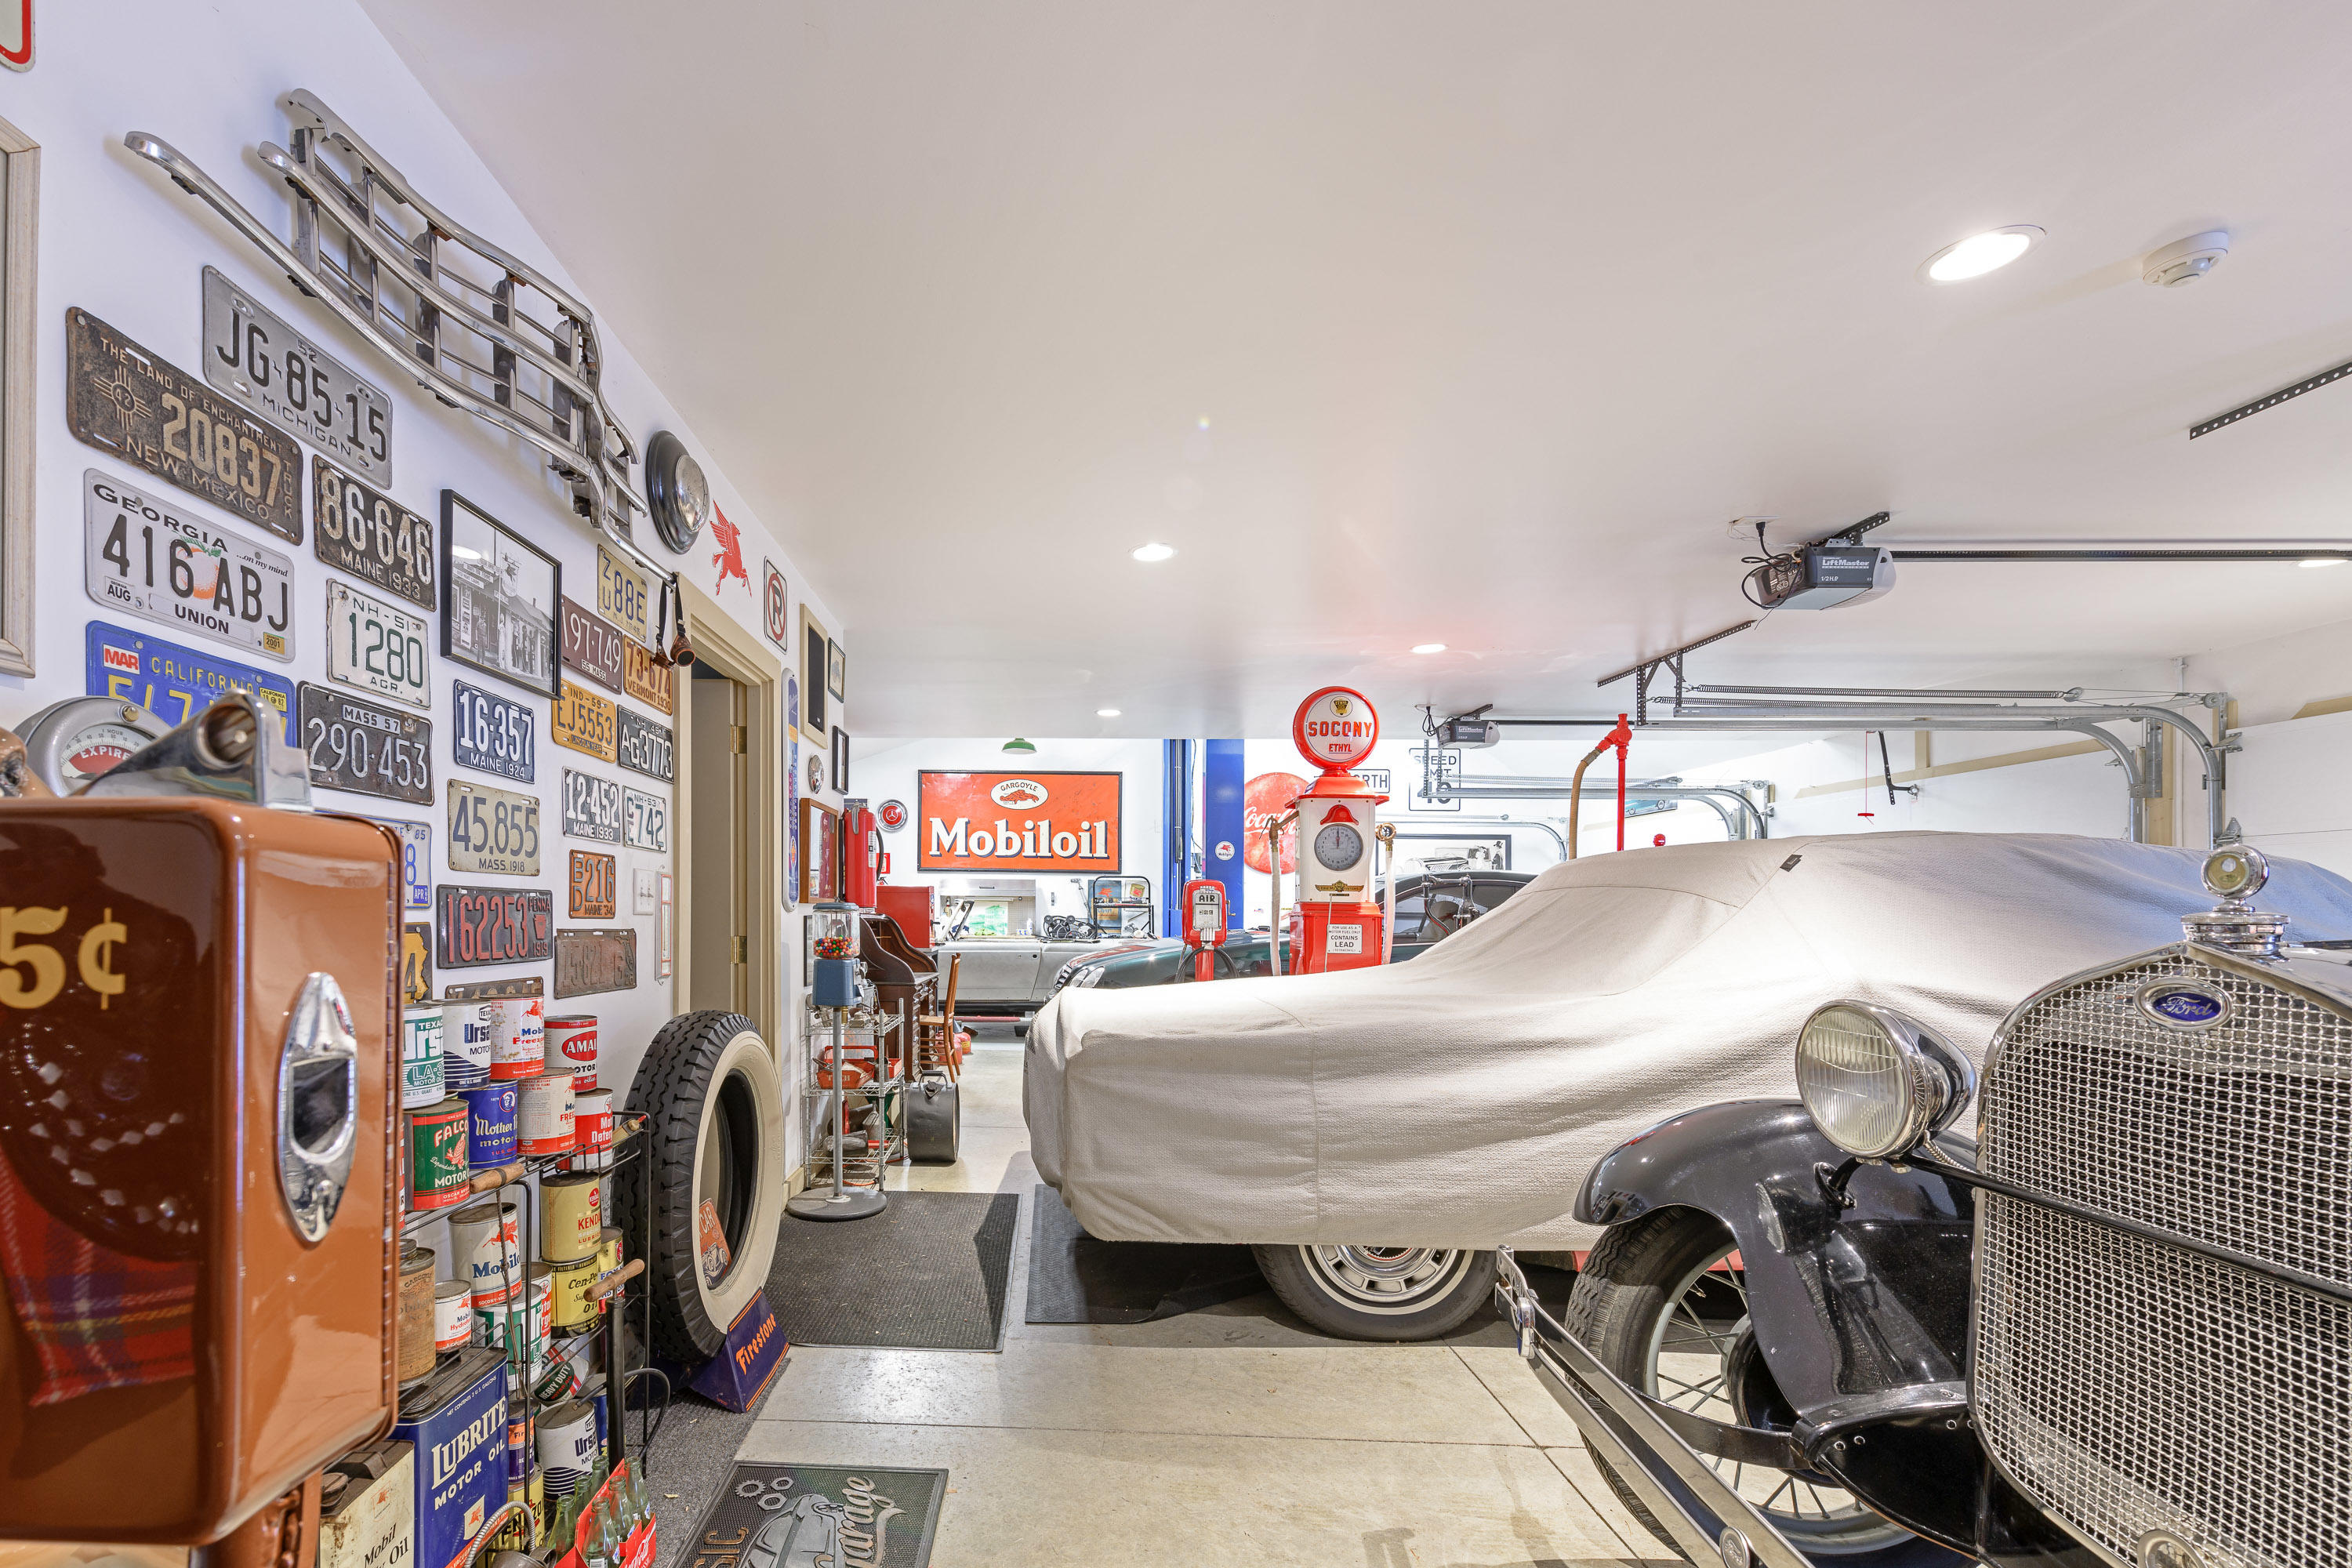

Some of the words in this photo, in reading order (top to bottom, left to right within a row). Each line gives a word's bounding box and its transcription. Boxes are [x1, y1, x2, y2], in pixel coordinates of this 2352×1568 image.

[100, 338, 128, 364] THE
[137, 359, 173, 390] LAND
[180, 383, 195, 400] OF
[204, 398, 282, 453] ENCHANTMENT
[262, 394, 351, 456] MICHIGAN
[162, 392, 281, 508] 20837
[126, 434, 180, 476] NEW
[192, 468, 269, 520] MEXICO
[283, 460, 292, 520] TRUCK
[93, 484, 228, 553] GEORGIA
[321, 469, 431, 584] 86-646
[103, 514, 194, 598] 416
[212, 557, 288, 632] ABJ
[255, 559, 267, 572] my
[268, 563, 288, 577] mind
[339, 547, 383, 583] MAINE
[388, 569, 420, 600] 1933
[107, 585, 131, 602] AUG
[175, 604, 229, 634] UNION
[267, 637, 280, 648] 2001
[349, 612, 423, 688] 1280
[104, 648, 139, 670] MAR
[582, 659, 590, 671] 55
[592, 665, 606, 680] MASS
[152, 657, 253, 694] CALIFORNIA
[370, 677, 403, 694] AGR.
[627, 679, 656, 703] VERMONT
[344, 706, 377, 726] MASS
[383, 717, 400, 731] 57
[459, 691, 532, 764] 16-357
[1308, 720, 1372, 737] SOCONY
[1329, 743, 1352, 753] ETHYL
[1414, 755, 1457, 765] SEED
[470, 753, 501, 771] MAINE
[506, 763, 525, 778] 1924
[566, 773, 619, 828] 12-452
[1000, 781, 1038, 792] GARGOYLE
[415, 829, 426, 840] 85
[452, 795, 539, 858] 45,855
[573, 822, 594, 837] MAINE
[596, 826, 613, 840] 1933
[636, 804, 664, 847] 742
[929, 817, 1109, 859] Mobiloil
[479, 858, 508, 871] MASS.
[510, 859, 524, 873] 1918
[414, 888, 424, 900] APR
[586, 858, 614, 902] 216
[528, 896, 550, 912] PENNA
[584, 904, 602, 916] MAINE
[448, 895, 528, 963] 162253
[533, 941, 548, 956] 1919
[2161, 996, 2213, 1017] Ford
[571, 1063, 596, 1073] OTOR
[475, 1113, 512, 1136] Mother
[480, 1136, 514, 1147] motor
[435, 1172, 466, 1188] MOTOR
[700, 1207, 716, 1235] CAR
[735, 1313, 776, 1376] Firestone
[455, 1396, 471, 1411] CONTENTS
[482, 1375, 496, 1389] GALLONS
[539, 1380, 556, 1400] HEAVY
[557, 1365, 571, 1383] DUTY
[431, 1396, 506, 1490] LUBRITE
[434, 1461, 481, 1511] MOTOR
[488, 1439, 505, 1461] OIL
[365, 1523, 396, 1568] Mobil
[390, 1537, 408, 1565] Oil
